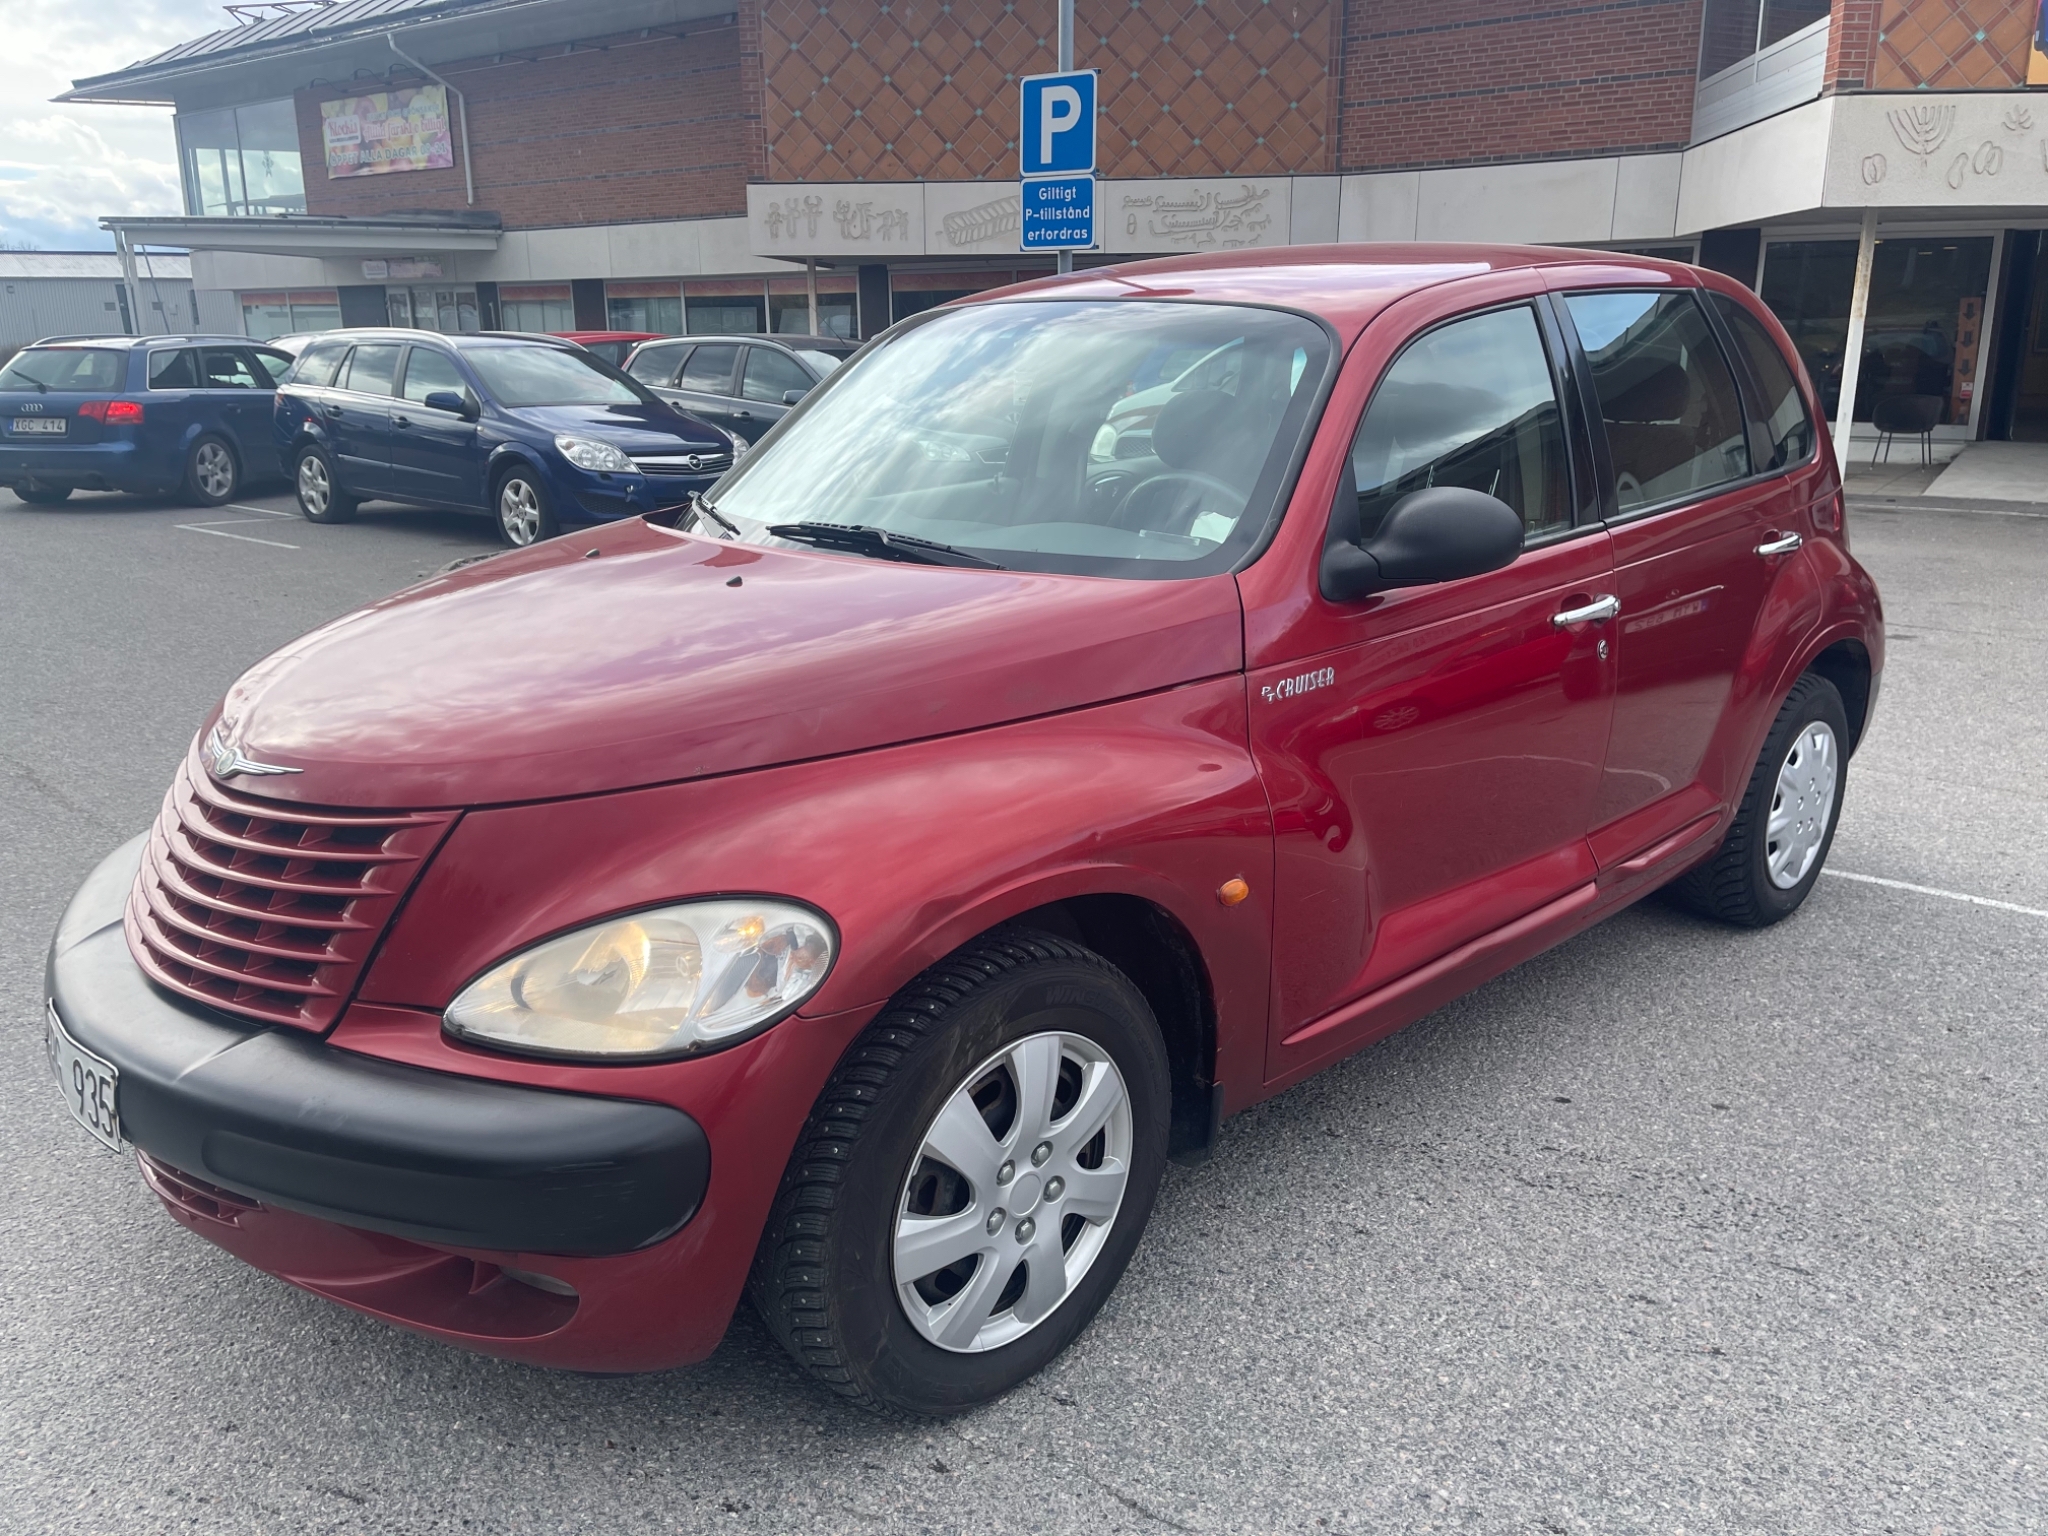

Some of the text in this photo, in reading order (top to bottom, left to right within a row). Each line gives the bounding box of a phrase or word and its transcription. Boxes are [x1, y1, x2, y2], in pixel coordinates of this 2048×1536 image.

[1040, 84, 1082, 165] P
[329, 151, 358, 166] ÖPPET
[360, 149, 383, 163] ALLA
[385, 146, 418, 160] DAGAR
[1038, 186, 1077, 202] Giltigt
[1025, 205, 1090, 221] P-tillstånd
[1027, 227, 1088, 241] erfordras
[14, 419, 63, 431] XGC 414
[1276, 666, 1335, 699] CRUISER
[72, 1058, 115, 1139] 935
